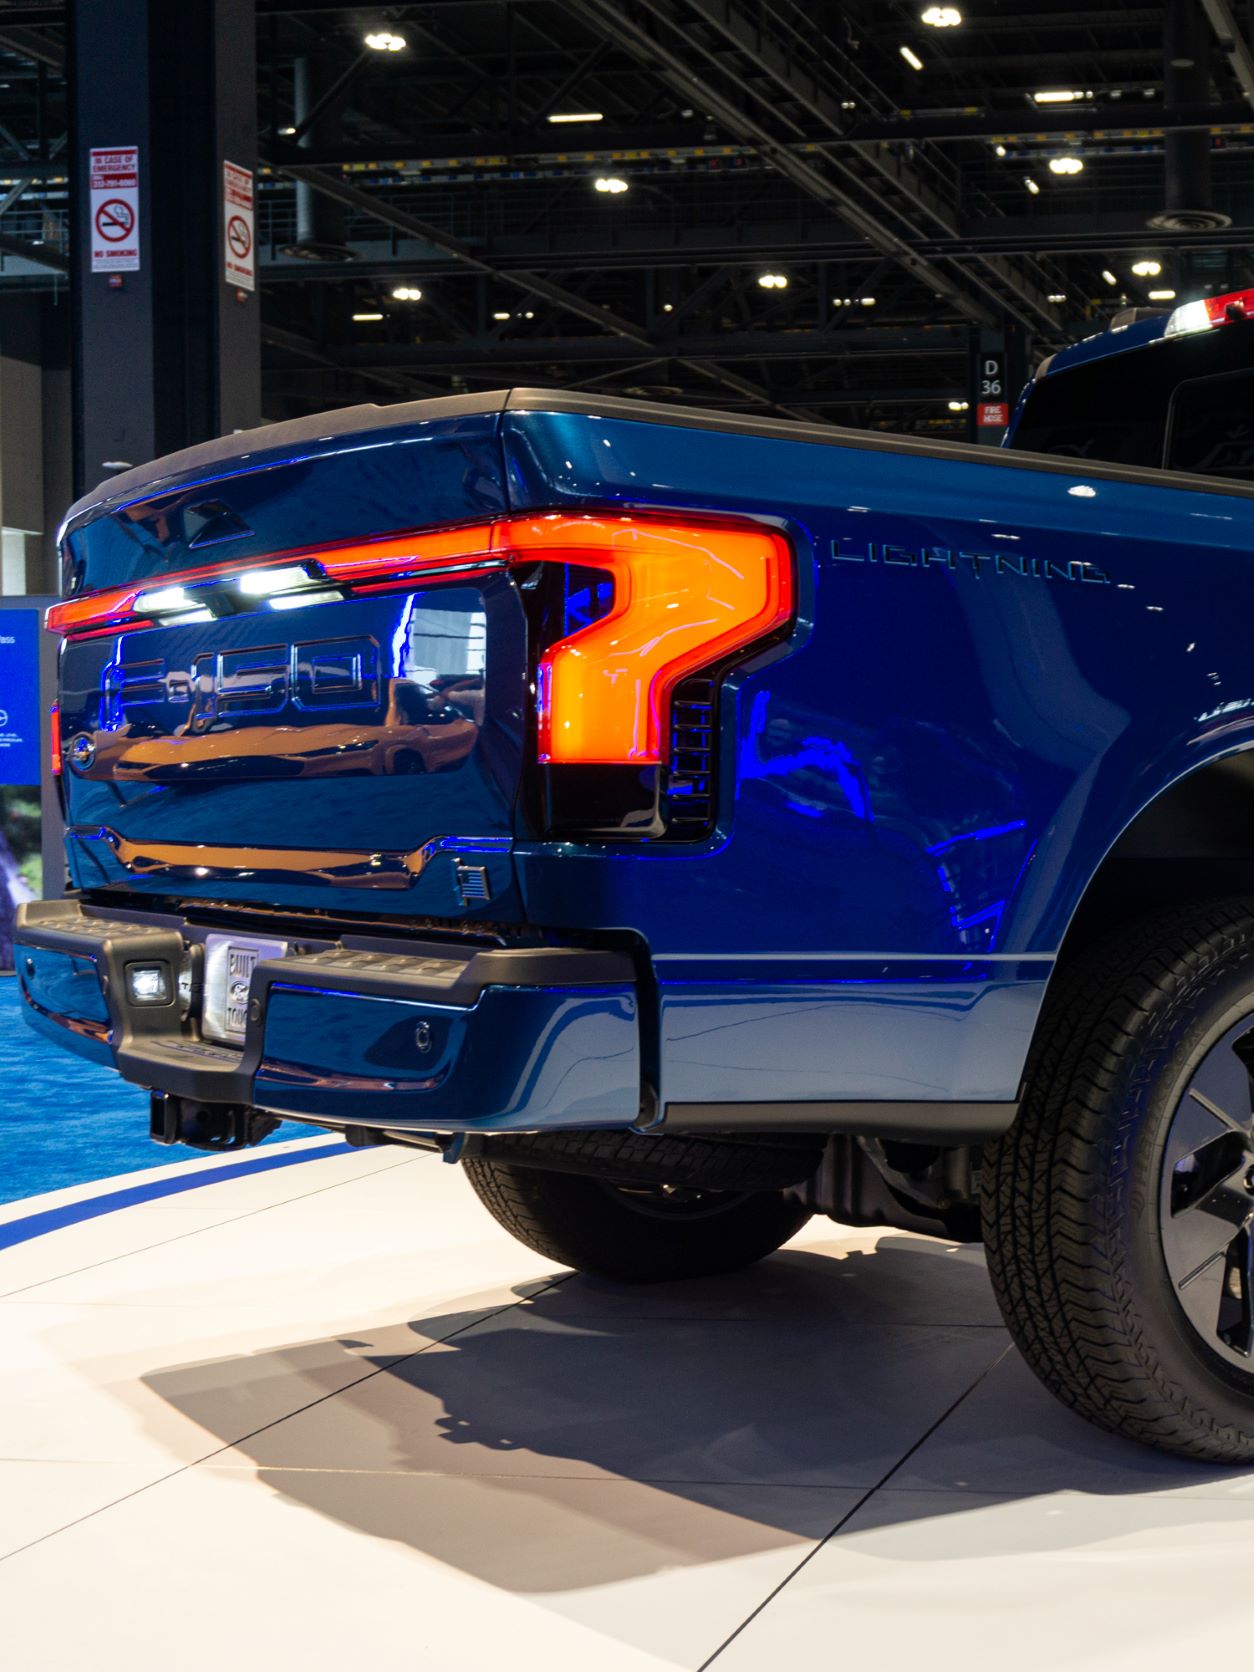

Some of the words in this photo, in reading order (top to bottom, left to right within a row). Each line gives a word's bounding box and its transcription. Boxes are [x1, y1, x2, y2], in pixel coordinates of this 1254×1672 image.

[93, 164, 135, 173] EMERGENCY
[94, 250, 104, 258] NO
[106, 248, 137, 257] SMOKING
[985, 360, 998, 375] D
[981, 380, 1002, 394] 36
[830, 539, 1111, 584] LIGHTNING
